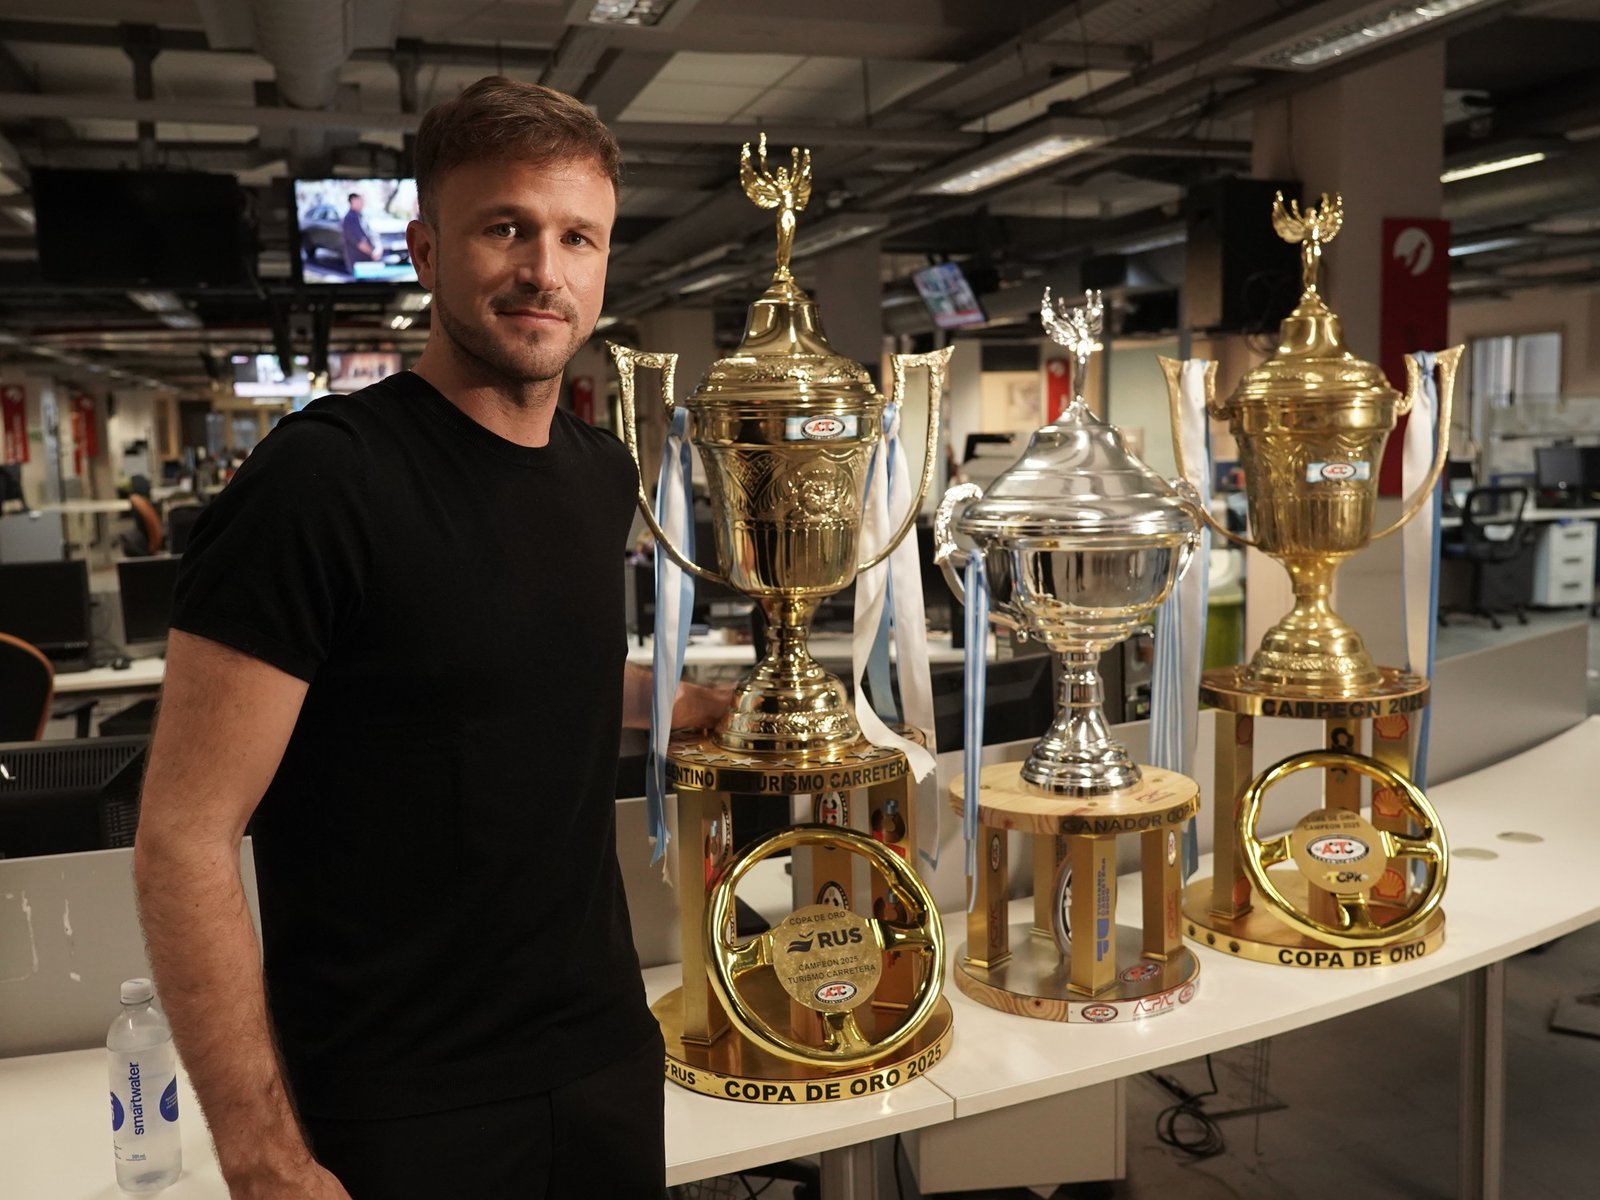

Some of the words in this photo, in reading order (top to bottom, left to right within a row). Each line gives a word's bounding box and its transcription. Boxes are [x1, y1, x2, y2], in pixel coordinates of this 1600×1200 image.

[1262, 699, 1381, 718] CAMPEON
[829, 758, 911, 788] CARRETERA
[1062, 814, 1162, 833] GANADOR
[790, 915, 813, 926] COPA
[814, 913, 826, 922] DE
[827, 911, 846, 920] ORO
[817, 927, 863, 948] RUS
[798, 959, 839, 972] CAMPEON
[841, 955, 859, 965] 2025
[1278, 949, 1344, 967] COPA
[1353, 950, 1382, 967] DE
[1389, 940, 1426, 963] ORO
[788, 972, 824, 984] TURISMO
[826, 964, 876, 978] CARRETERA
[671, 1063, 696, 1085] RUS
[724, 1080, 796, 1102] COPA
[805, 1082, 841, 1102] DE
[850, 1068, 901, 1094] ORO
[907, 1043, 942, 1080] 2025
[128, 1062, 145, 1135] smartwater
